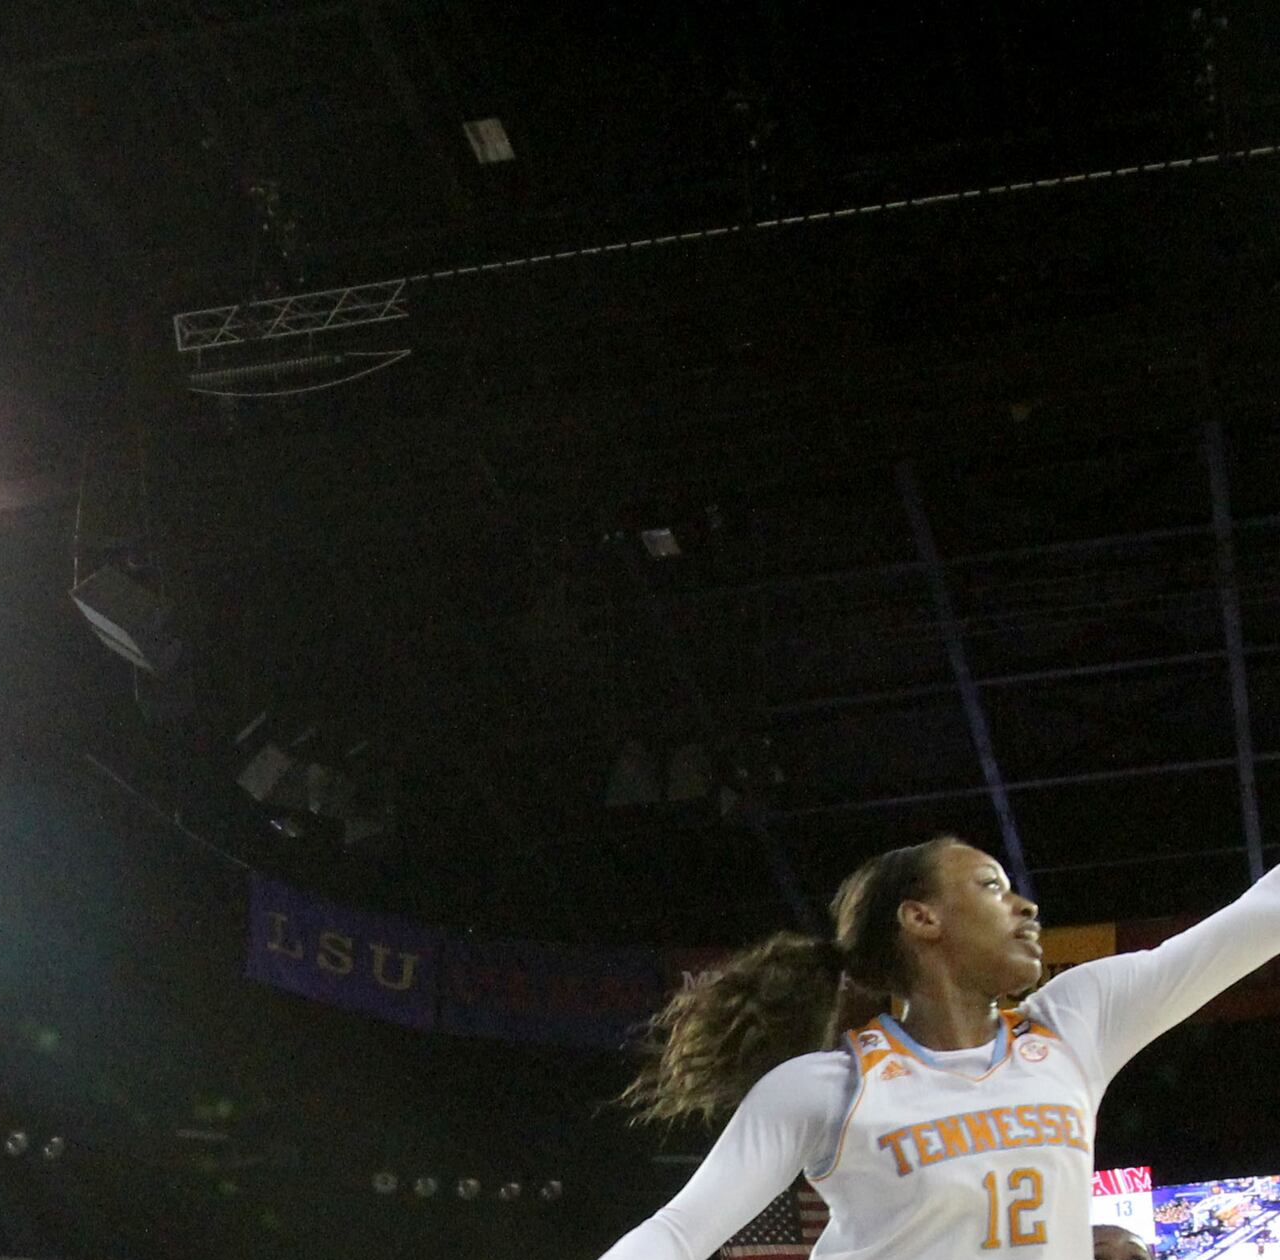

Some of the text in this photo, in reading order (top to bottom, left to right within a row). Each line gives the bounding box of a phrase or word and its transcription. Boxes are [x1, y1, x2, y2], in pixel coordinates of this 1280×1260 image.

[265, 909, 419, 991] LSU
[877, 1103, 1090, 1178] TENNESSE
[981, 1166, 1048, 1250] 12
[1114, 1200, 1134, 1217] 13
